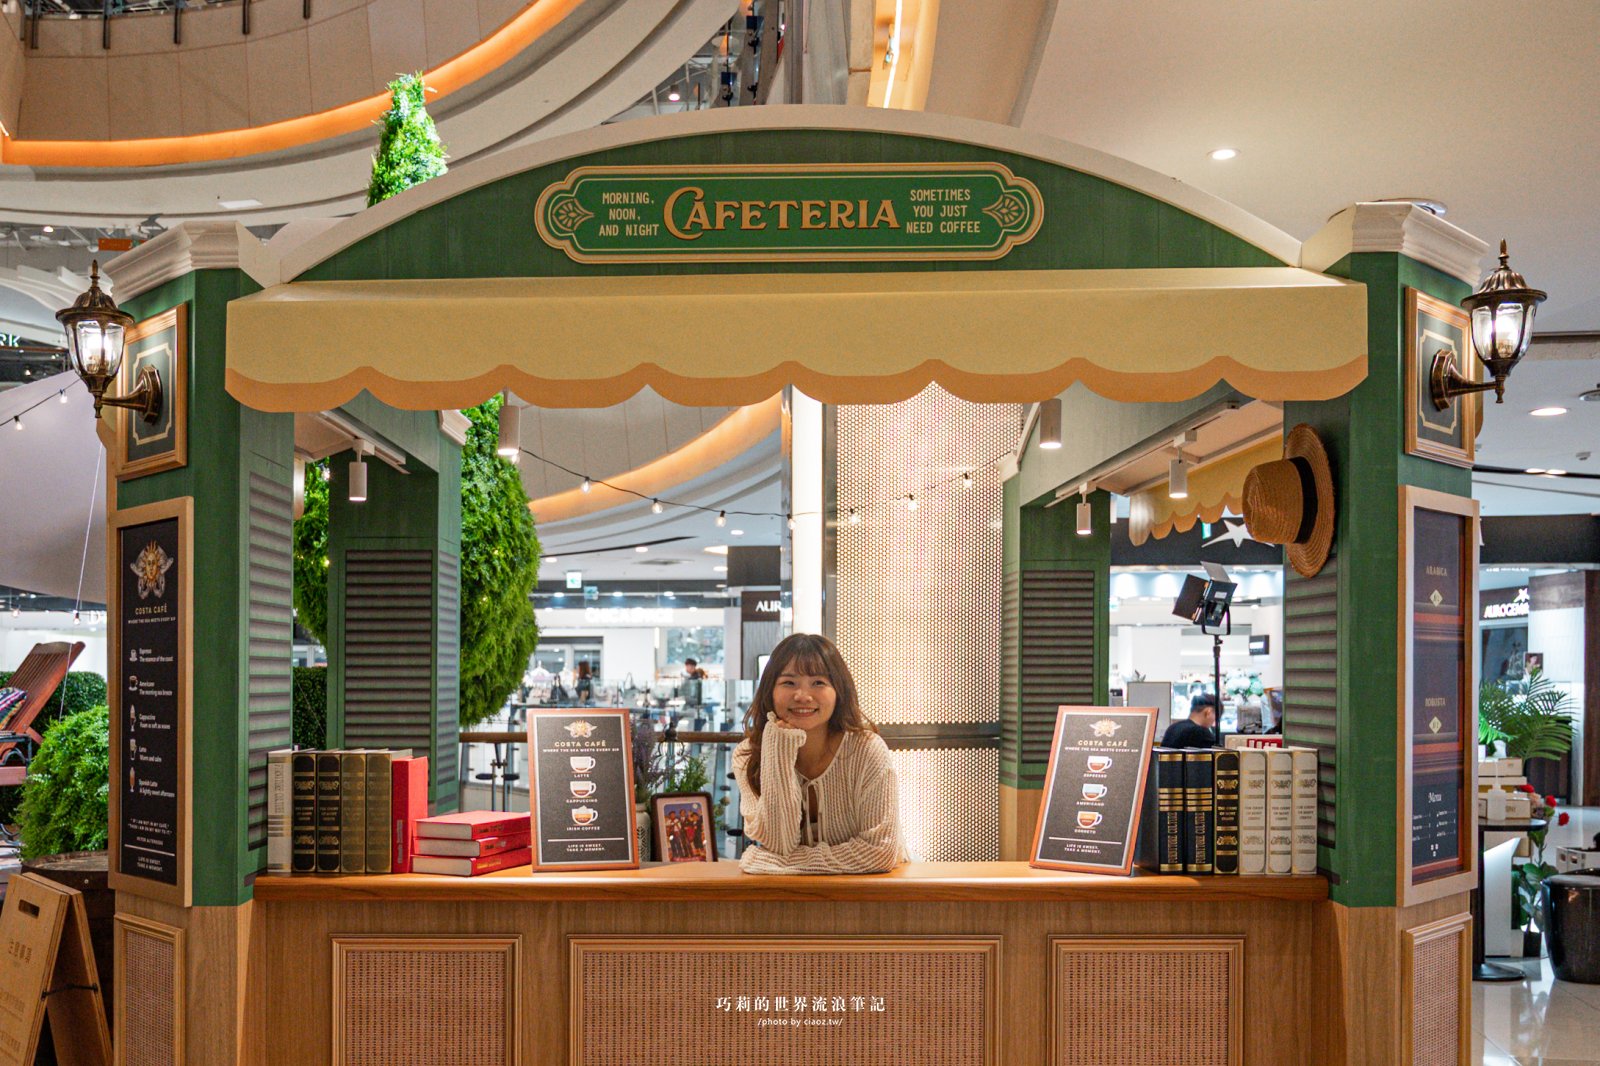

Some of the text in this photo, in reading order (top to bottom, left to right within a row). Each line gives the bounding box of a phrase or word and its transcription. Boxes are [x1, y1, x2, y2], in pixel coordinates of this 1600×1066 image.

[910, 188, 971, 201] SOMETIMES
[663, 186, 902, 240] CAFETERIA
[912, 205, 968, 217] YOU JUST
[599, 223, 659, 237] AND NIGHT
[906, 220, 981, 234] NEED COFFEE
[135, 606, 152, 615] COSTA
[584, 739, 607, 747] CAFÉ
[1106, 739, 1128, 747] CAFÉ
